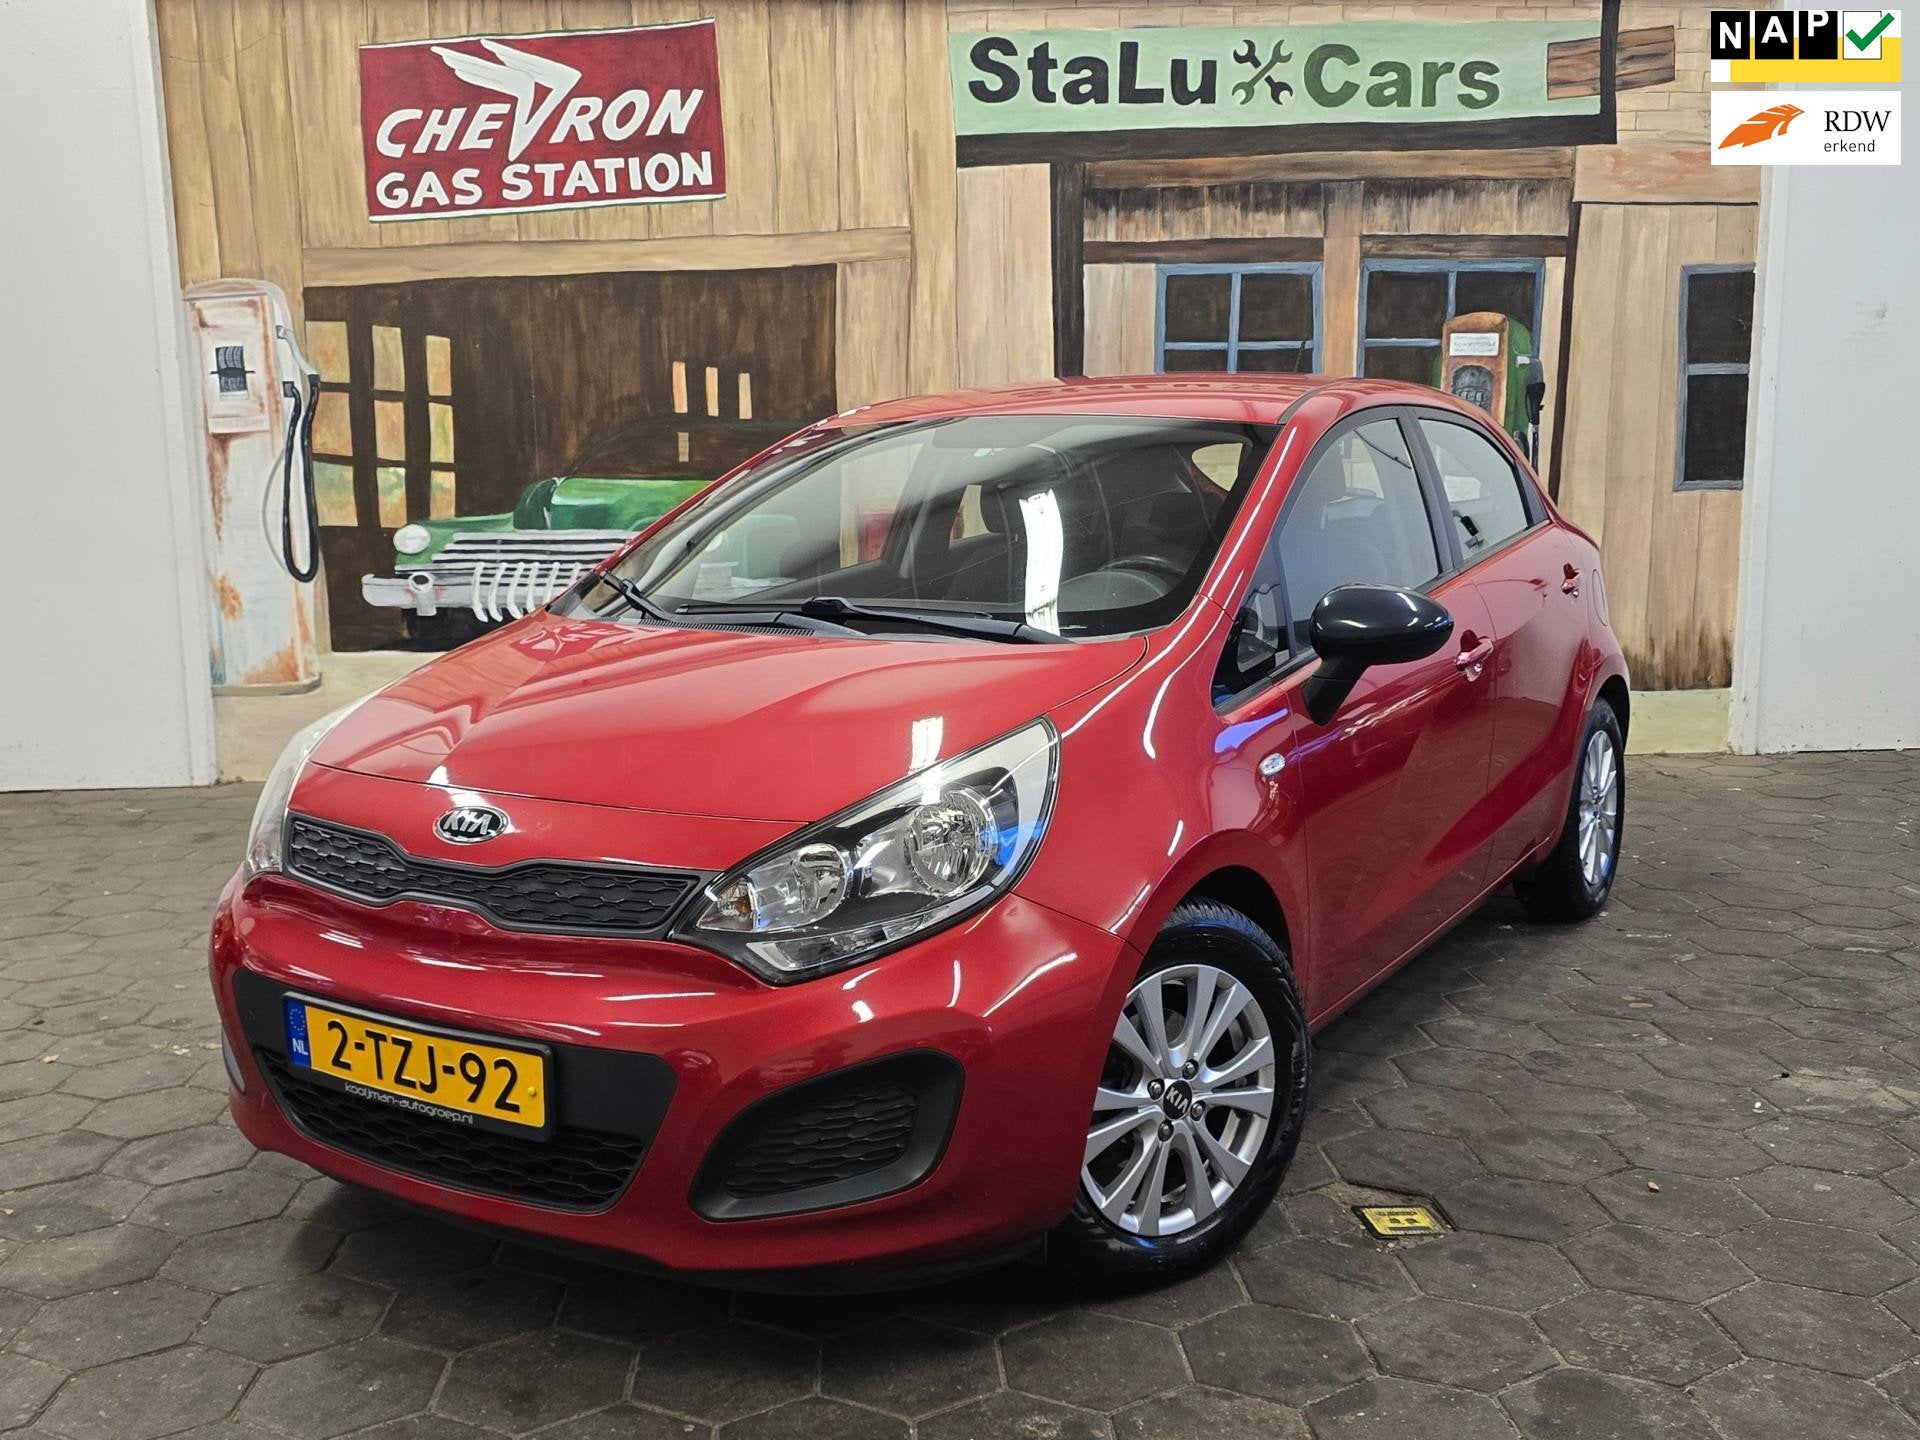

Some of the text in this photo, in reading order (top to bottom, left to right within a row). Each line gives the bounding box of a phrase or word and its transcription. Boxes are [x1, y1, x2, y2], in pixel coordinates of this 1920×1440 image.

[968, 36, 1501, 109] StaLu Cars
[375, 70, 704, 161] CHEVRON
[375, 151, 713, 209] GAS STATION
[292, 1038, 308, 1055] NL
[327, 1020, 520, 1113] 2-TZJ-92
